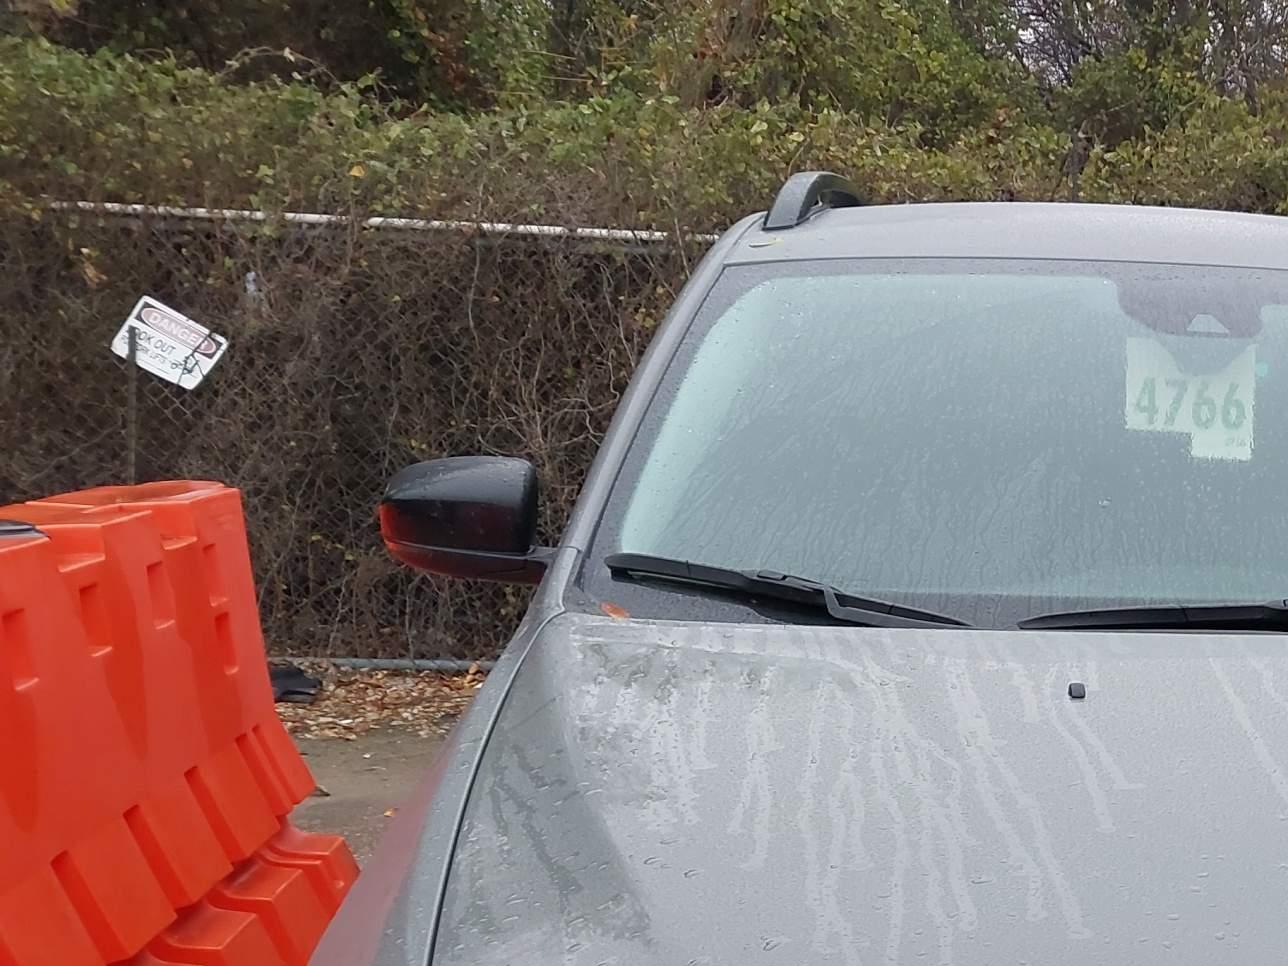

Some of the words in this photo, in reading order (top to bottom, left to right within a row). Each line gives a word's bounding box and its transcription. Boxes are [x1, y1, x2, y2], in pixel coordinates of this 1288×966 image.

[148, 311, 208, 351] DANGER
[154, 339, 176, 356] OUT
[1135, 376, 1247, 430] 4766
